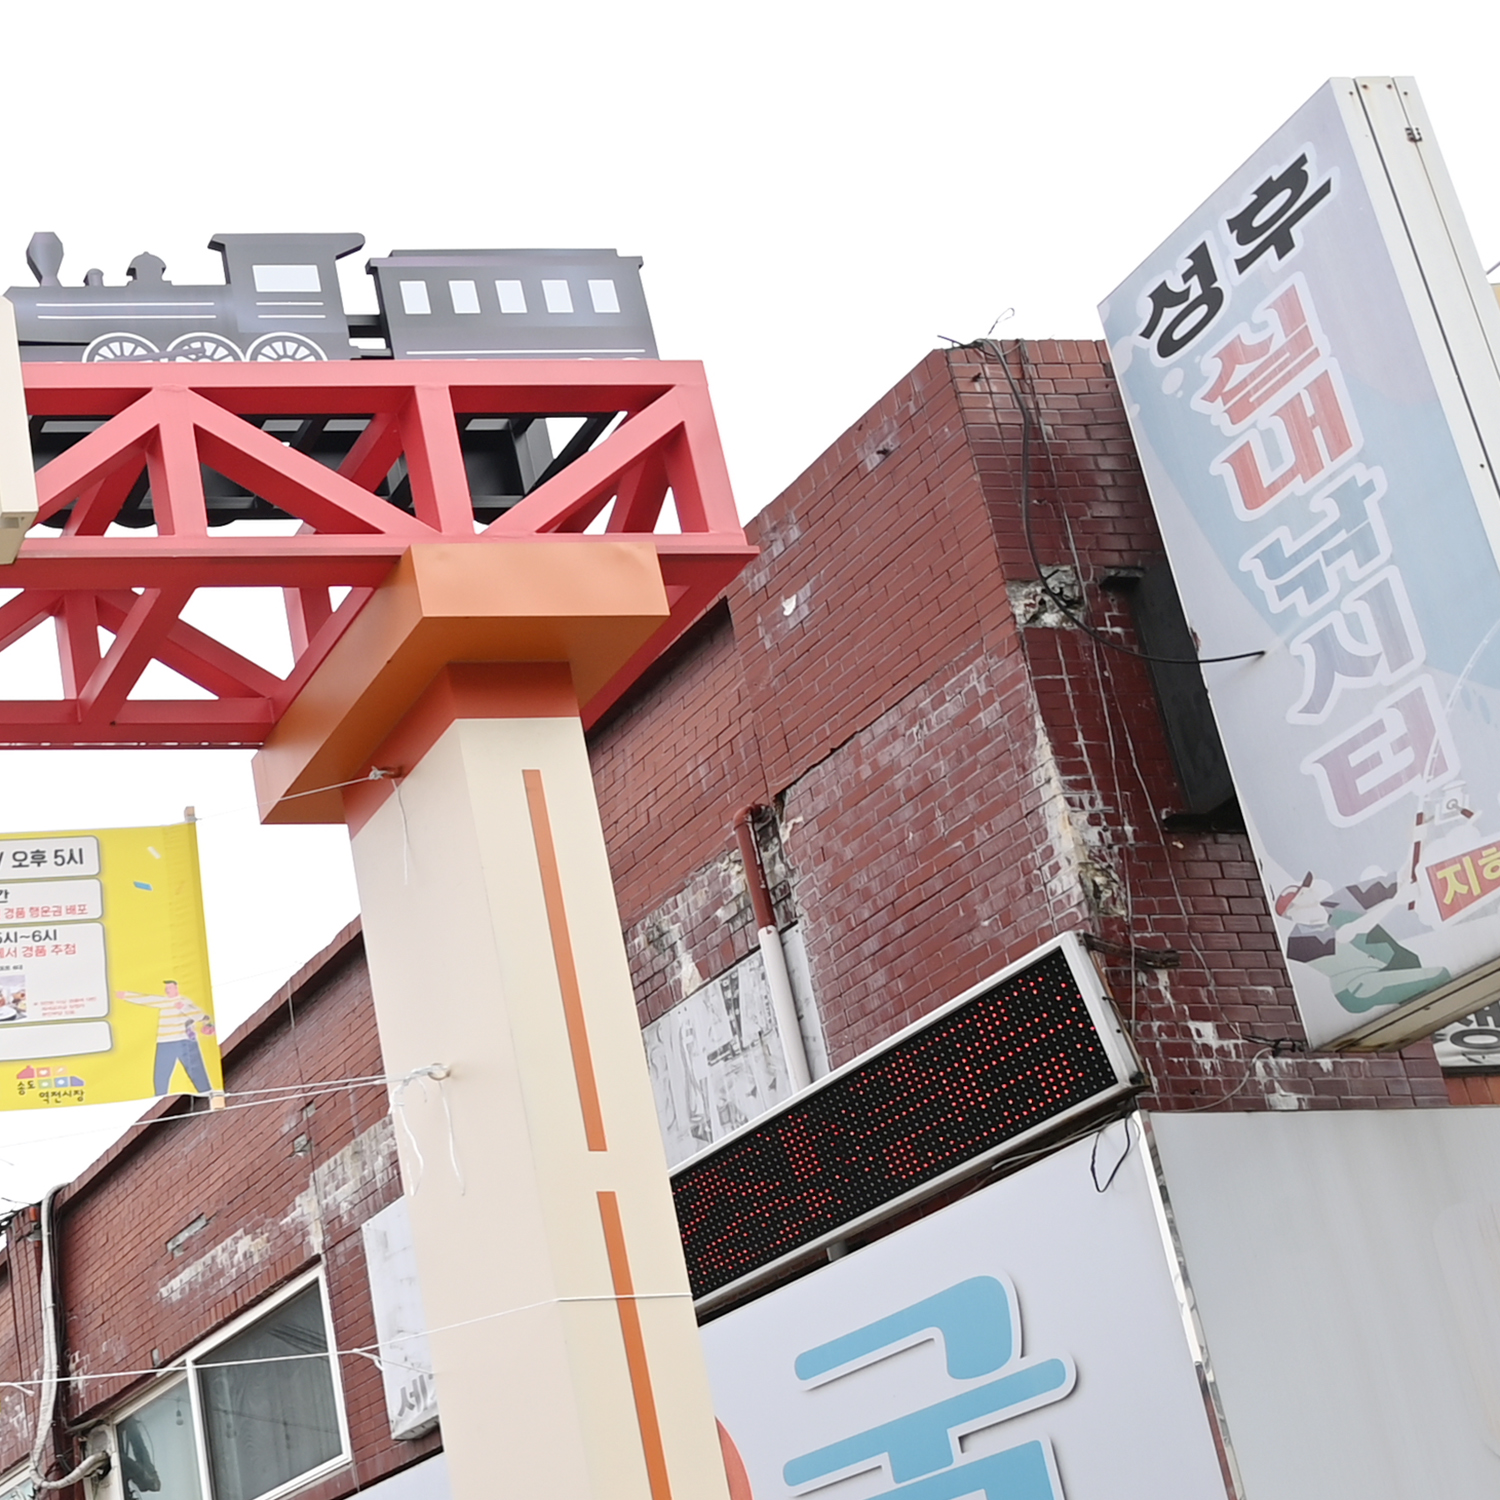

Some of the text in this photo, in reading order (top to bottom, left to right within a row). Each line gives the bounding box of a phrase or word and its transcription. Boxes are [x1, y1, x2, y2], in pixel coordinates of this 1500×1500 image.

[1139, 152, 1333, 358] 성후
[12, 850, 47, 868] 오후
[54, 849, 83, 866] 5시
[17, 1080, 35, 1095] 송도
